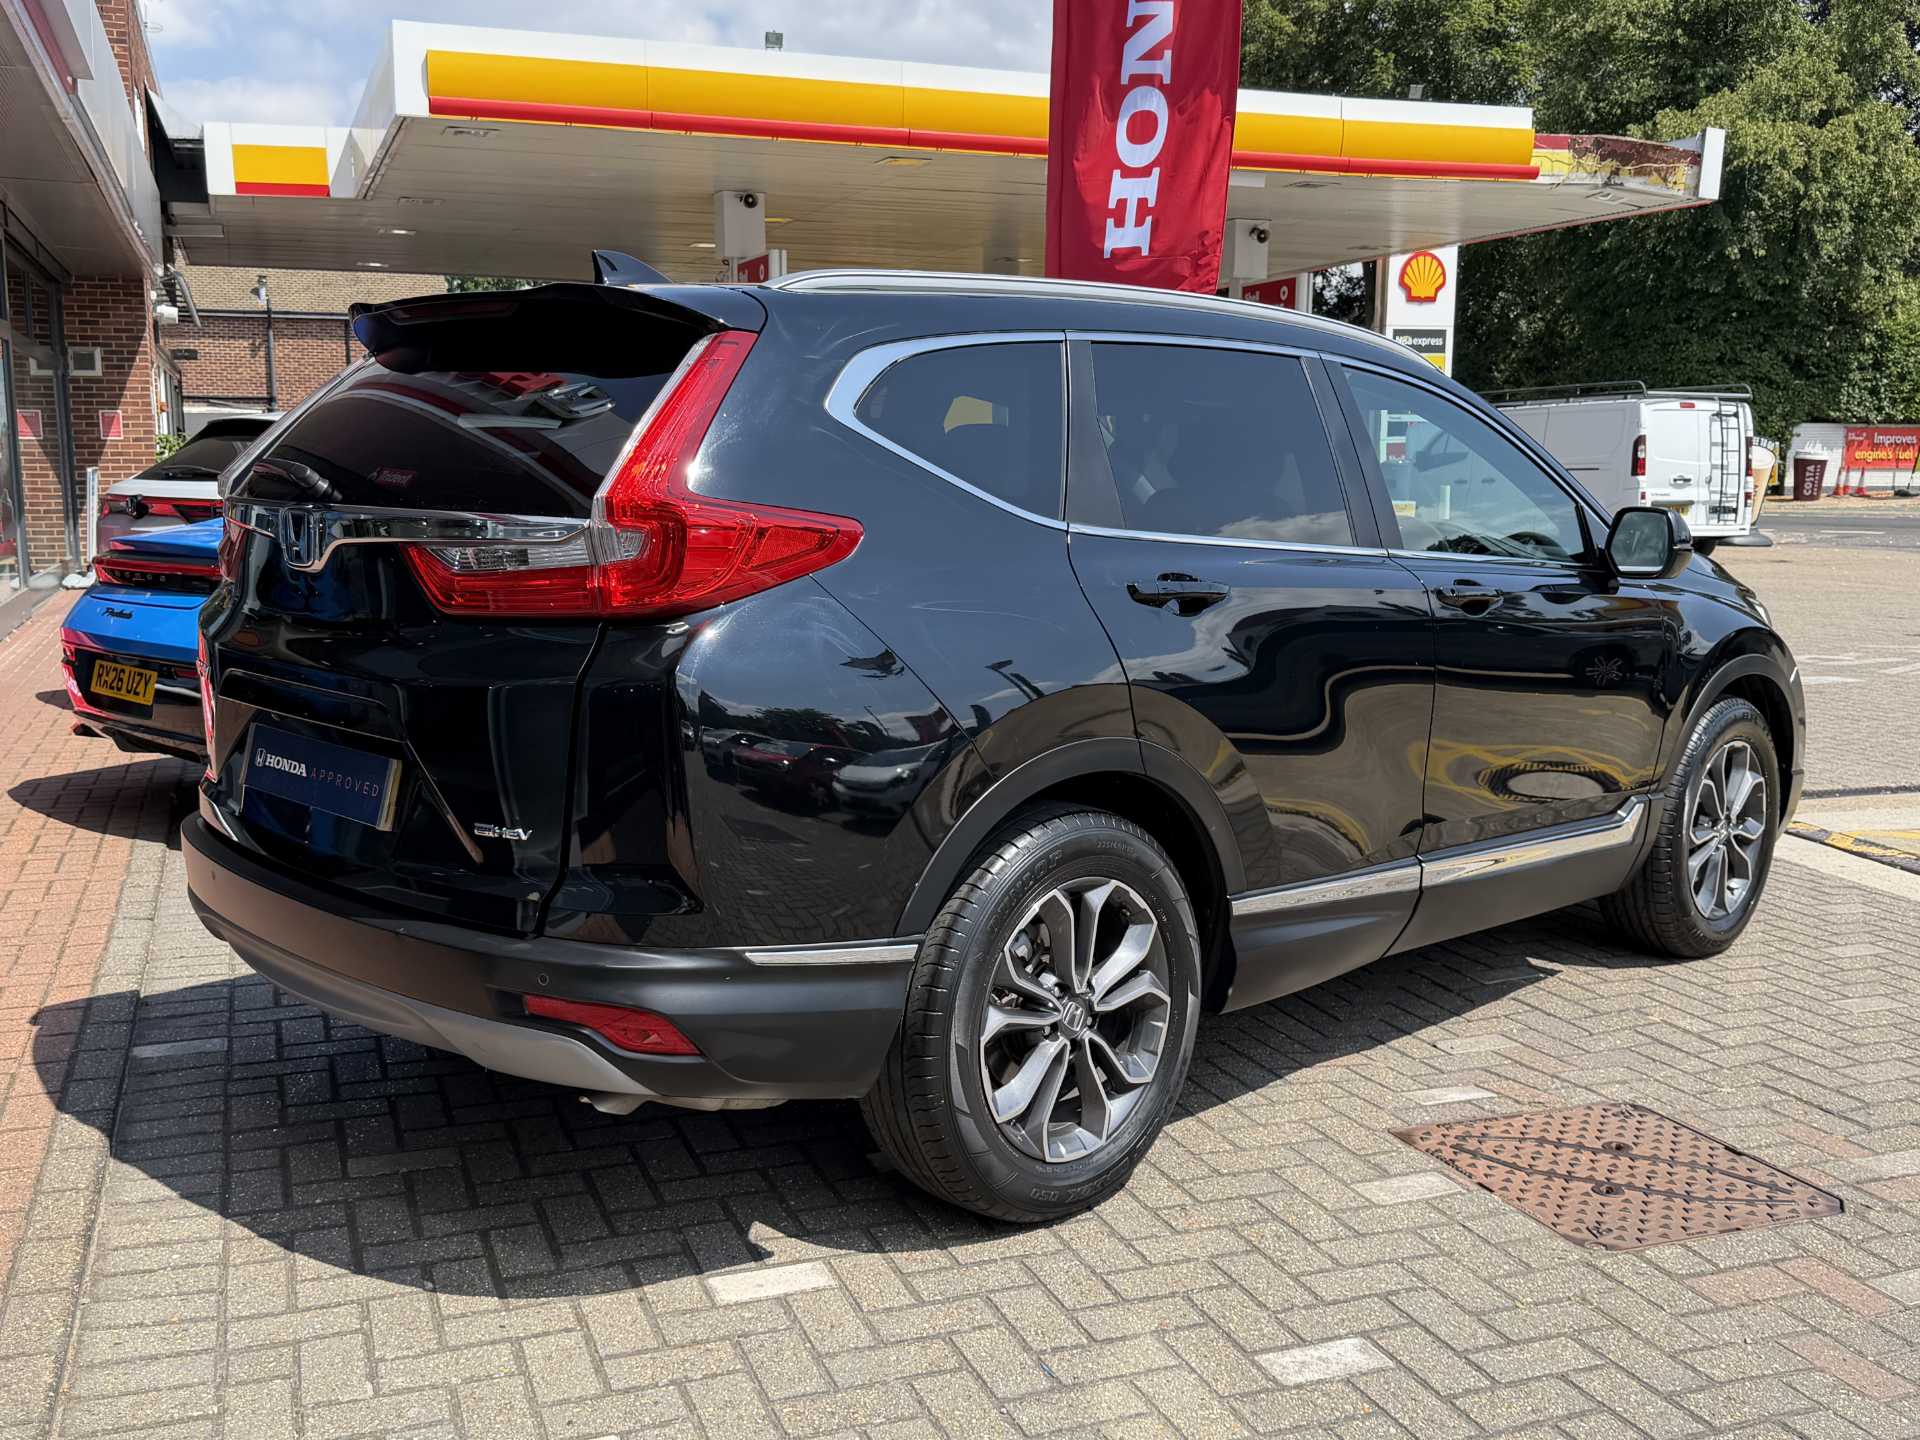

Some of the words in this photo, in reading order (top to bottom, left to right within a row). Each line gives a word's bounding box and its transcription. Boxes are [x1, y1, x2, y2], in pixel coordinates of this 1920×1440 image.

[1413, 336, 1443, 347] express
[1873, 432, 1917, 447] Improves
[1803, 464, 1816, 497] COSTA
[95, 663, 126, 692] RX26
[126, 669, 152, 698] UZY
[265, 753, 307, 778] HONDA
[311, 767, 379, 798] APPROVED
